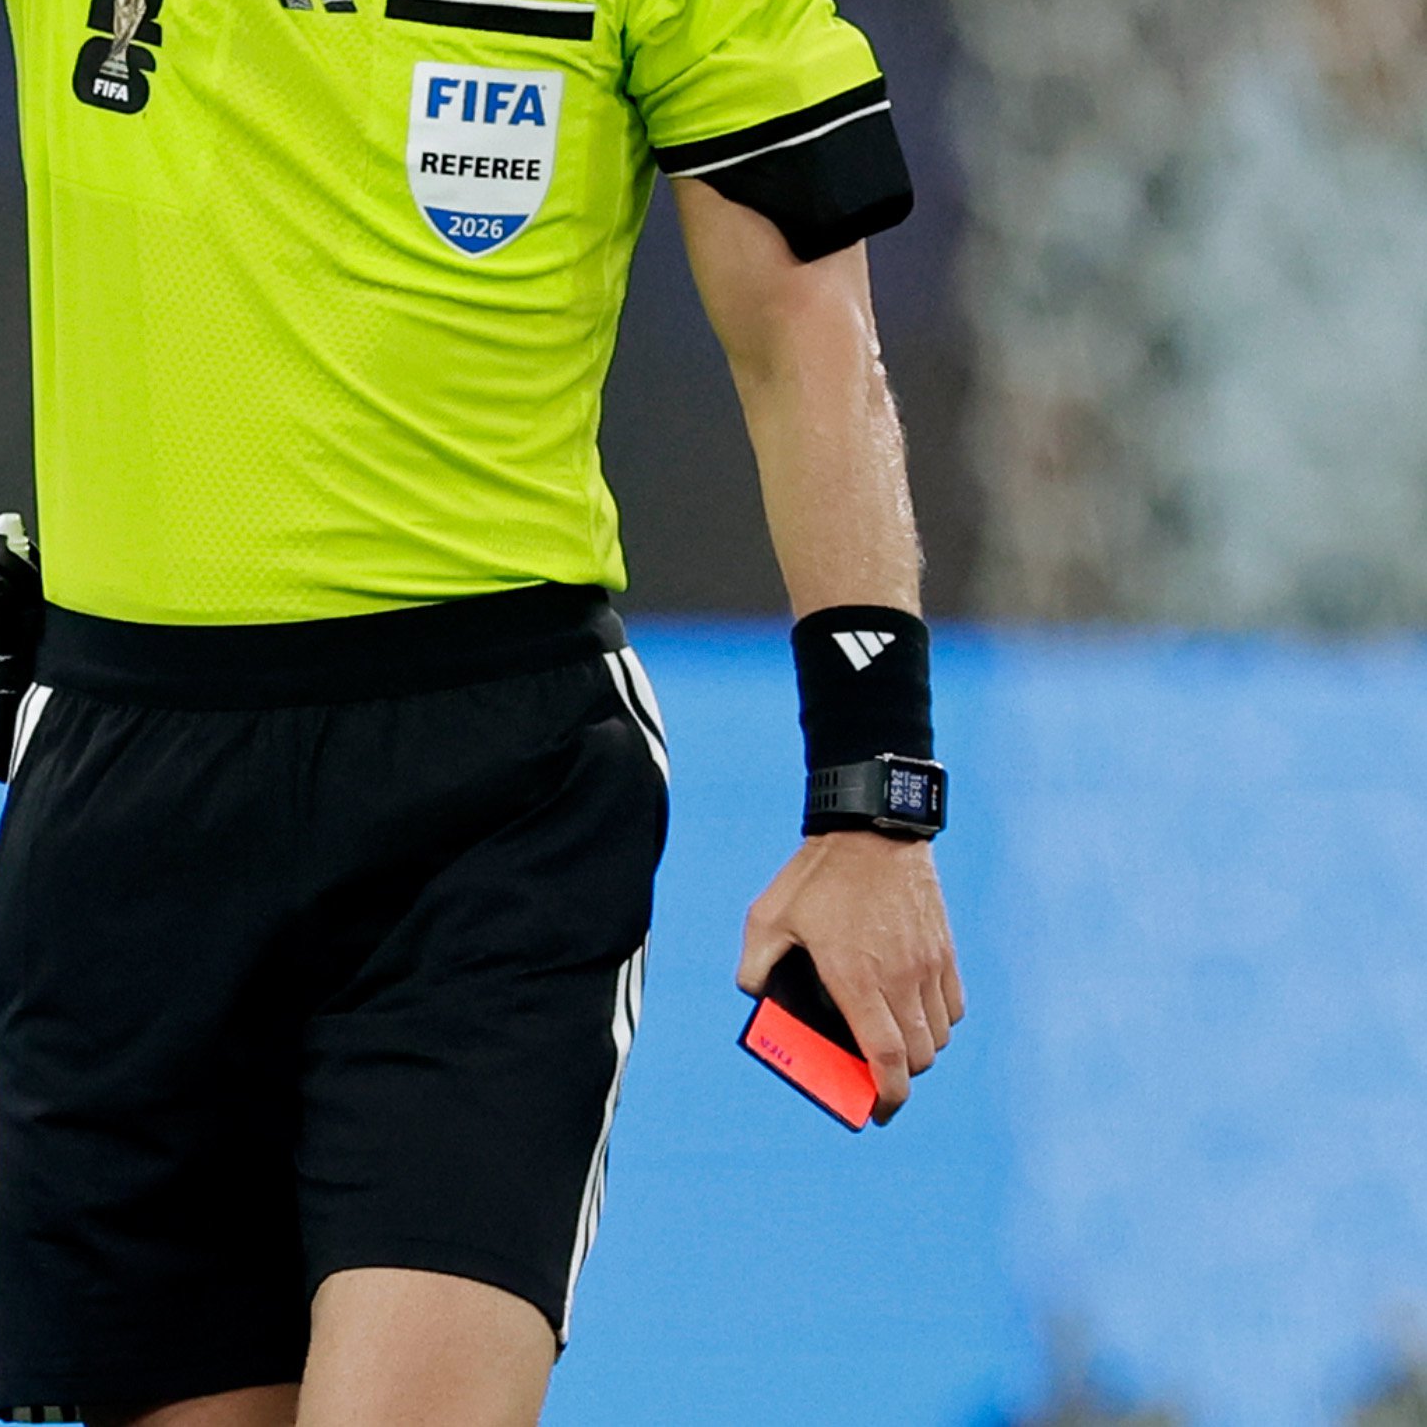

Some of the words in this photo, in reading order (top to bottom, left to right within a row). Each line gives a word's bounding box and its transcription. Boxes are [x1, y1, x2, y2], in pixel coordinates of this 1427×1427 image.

[92, 77, 130, 103] FIFA
[425, 76, 547, 127] FIFA
[420, 151, 542, 182] REFEREE
[447, 215, 505, 240] 2026
